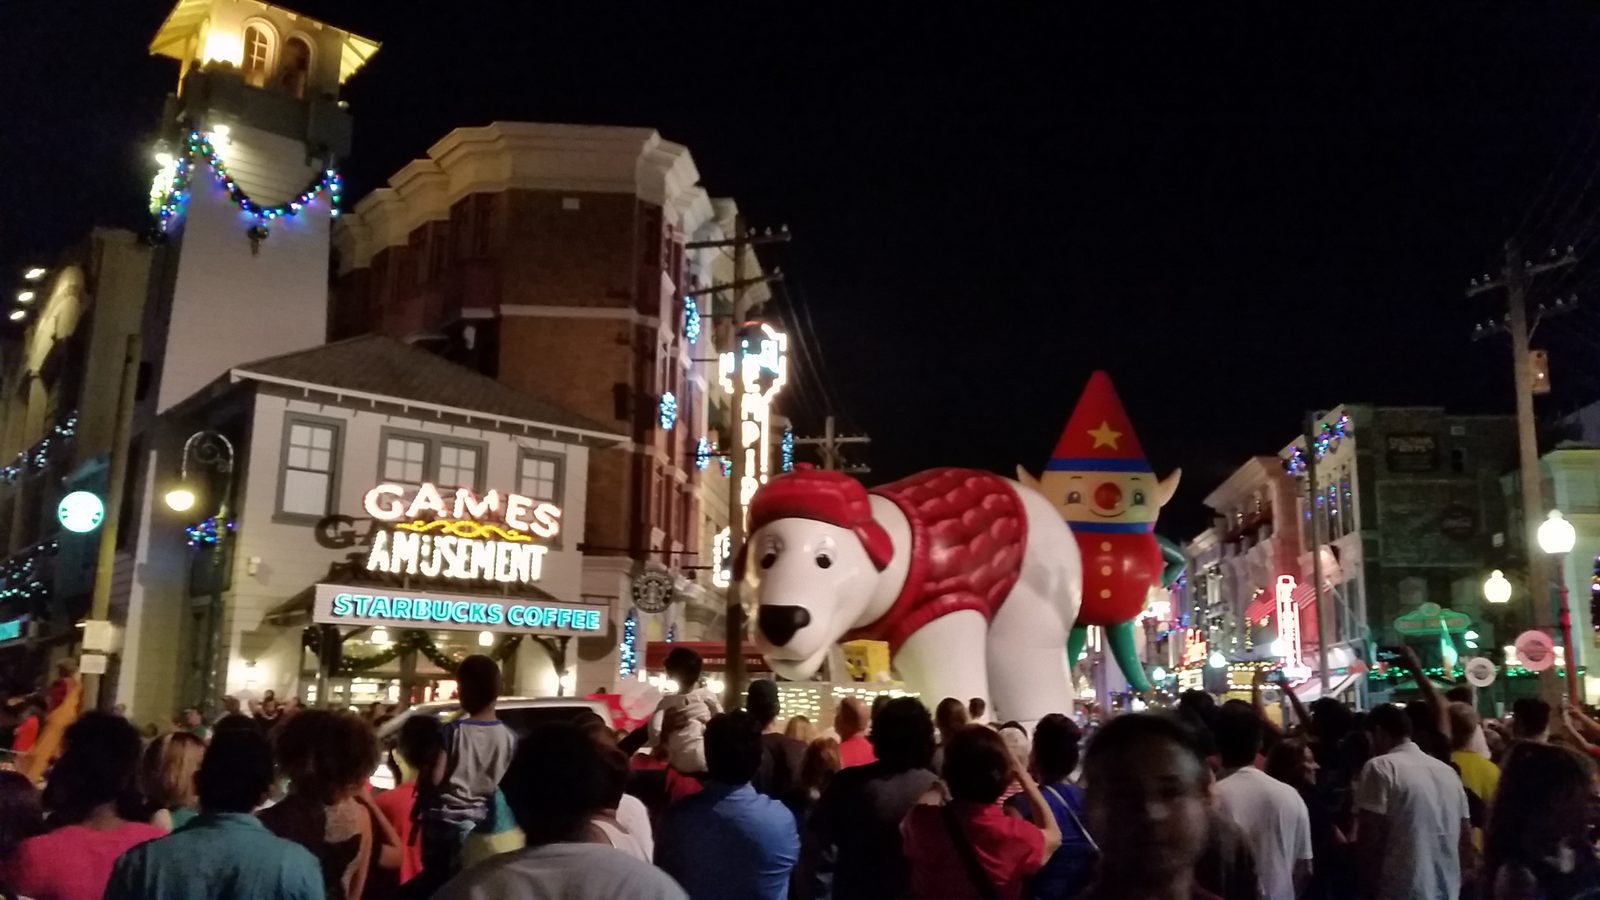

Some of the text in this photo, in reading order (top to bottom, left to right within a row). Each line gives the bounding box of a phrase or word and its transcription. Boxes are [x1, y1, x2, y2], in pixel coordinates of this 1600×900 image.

[364, 483, 562, 538] GAMES
[366, 530, 548, 583] AMUSEMENT
[333, 593, 600, 630] STARBUCKS COFFEE
